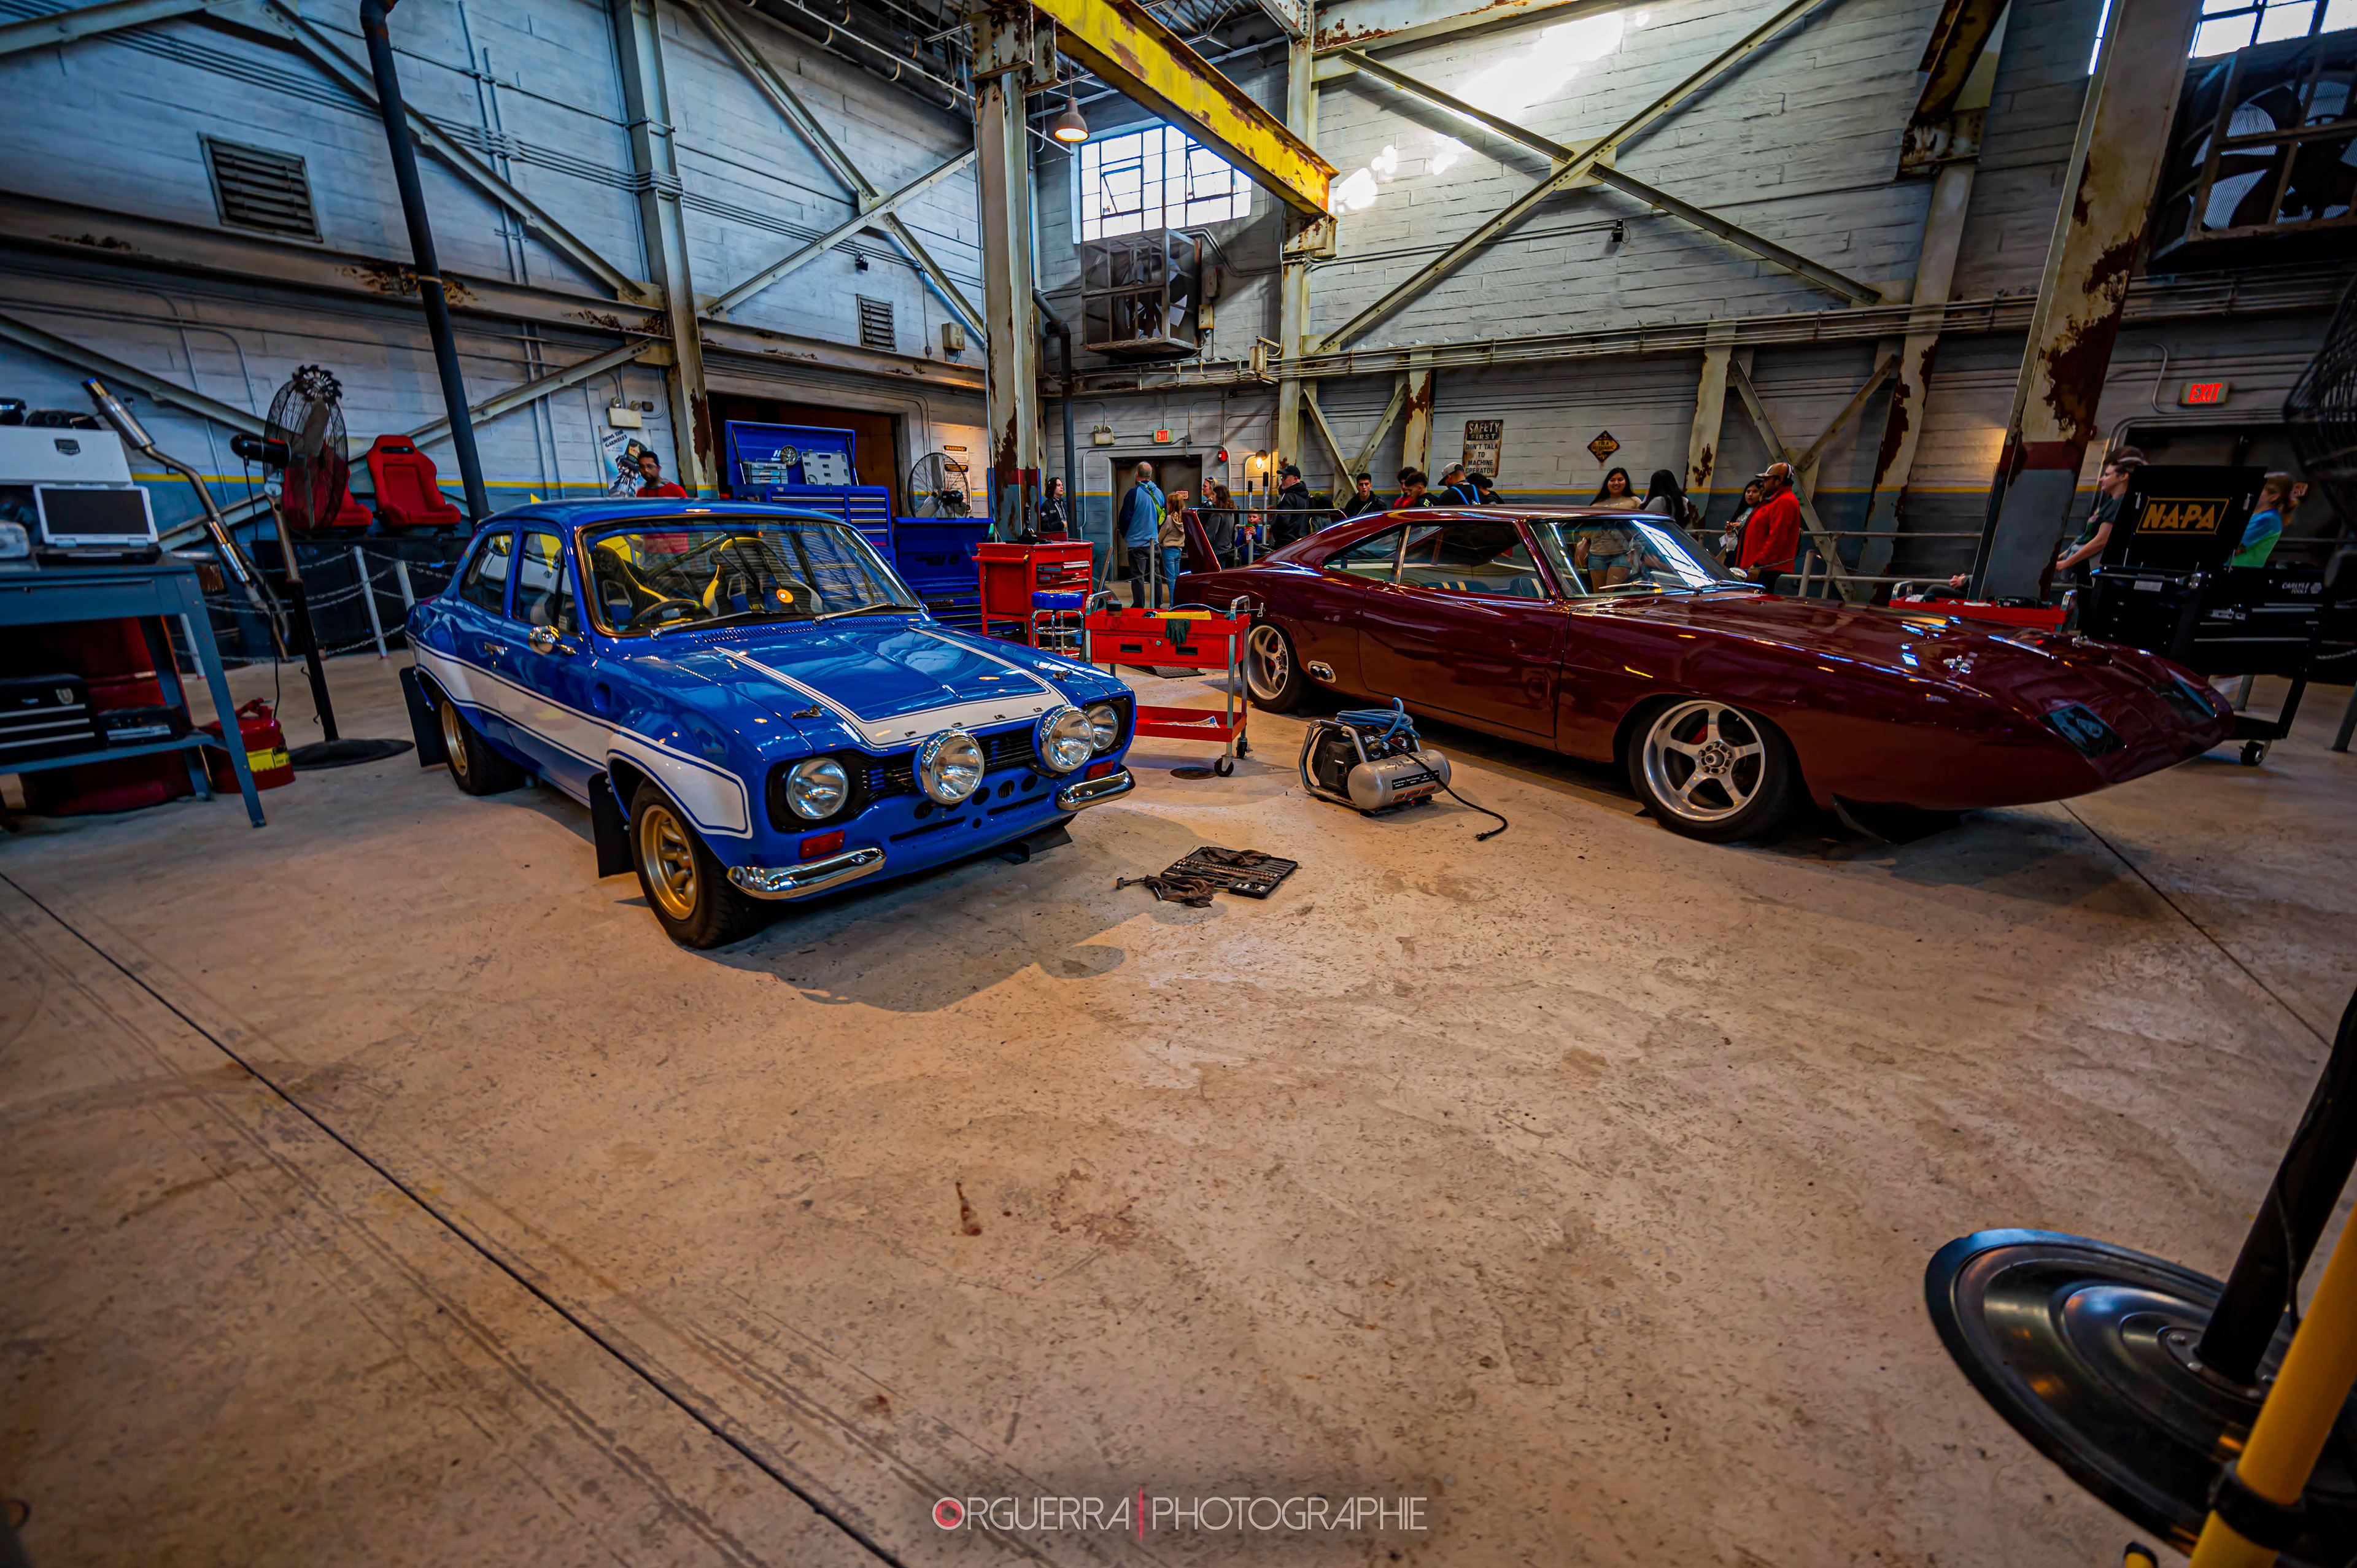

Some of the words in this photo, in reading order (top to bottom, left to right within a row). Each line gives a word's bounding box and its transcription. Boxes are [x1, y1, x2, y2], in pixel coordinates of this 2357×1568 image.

[2188, 383, 2223, 403] EXIT
[1469, 422, 1500, 434] SAFETY
[1156, 430, 1168, 441] EXIT
